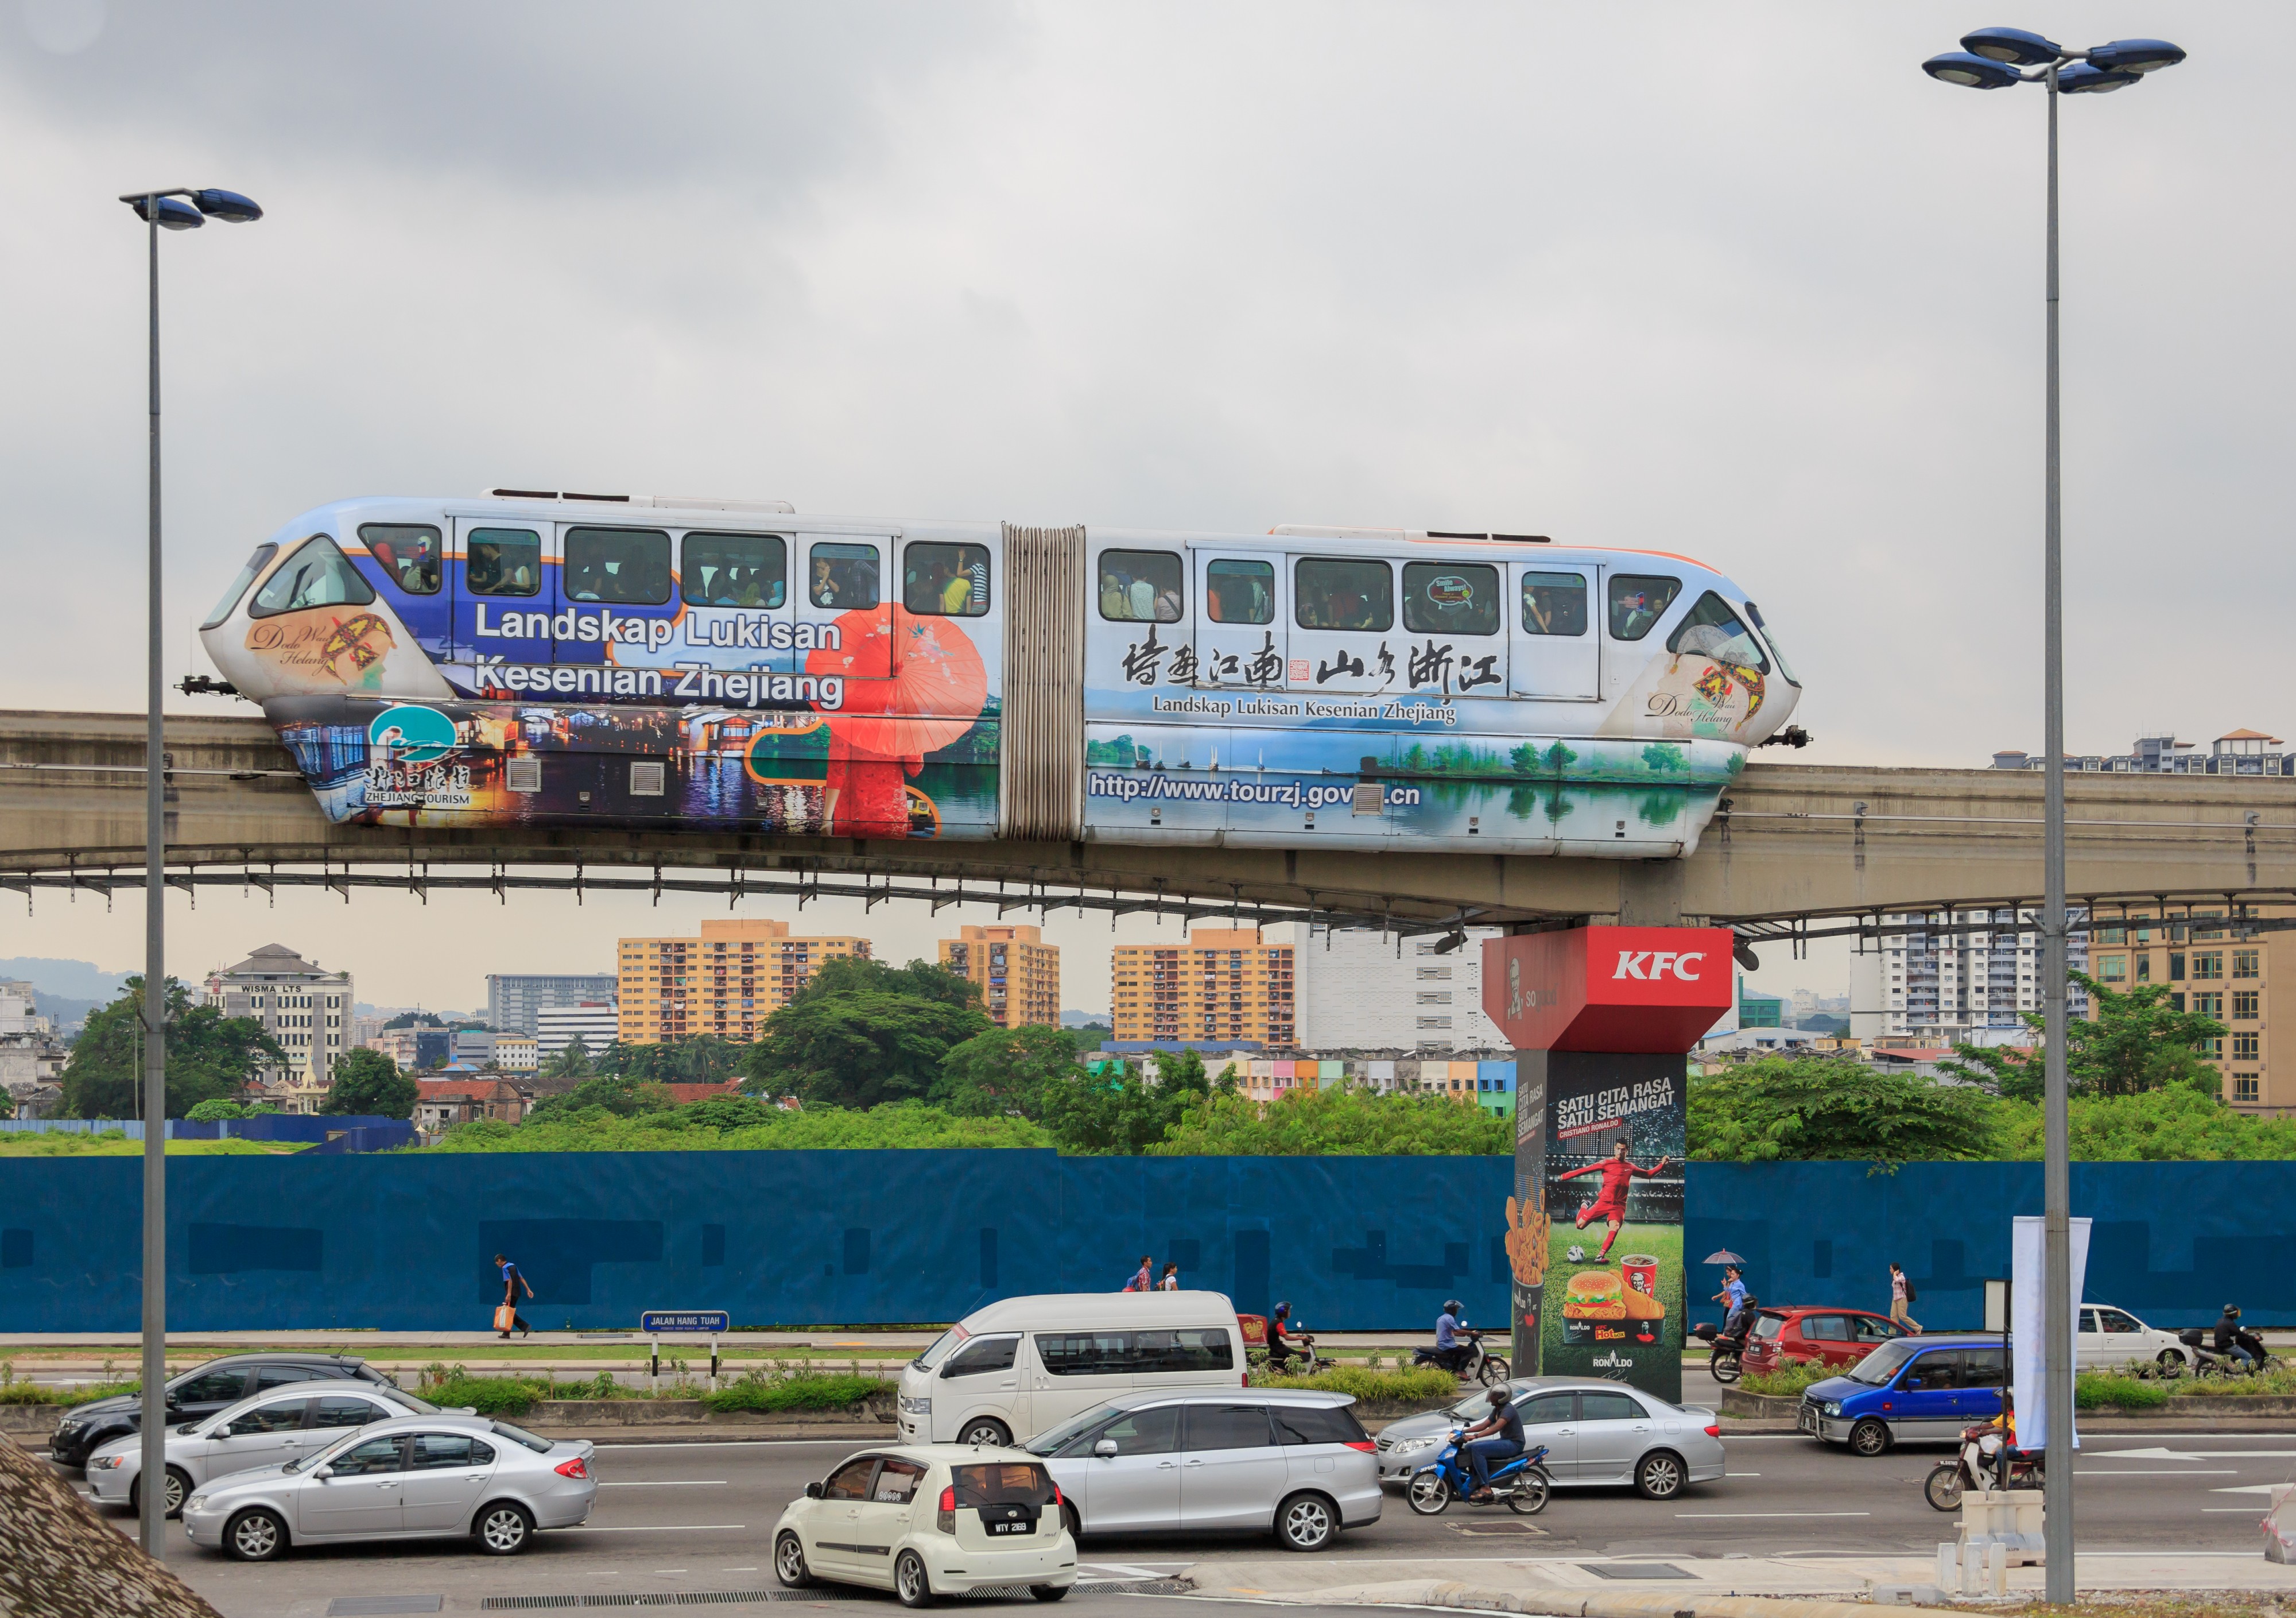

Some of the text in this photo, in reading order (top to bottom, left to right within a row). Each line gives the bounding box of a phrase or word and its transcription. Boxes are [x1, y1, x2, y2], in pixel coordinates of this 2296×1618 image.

[1444, 584, 1466, 592] Always!
[250, 624, 300, 650] Dodo
[476, 604, 840, 652] Landskap Lukisan
[280, 651, 329, 676] Helang
[476, 655, 842, 709] Kesenian Zhejiang
[1154, 696, 1456, 725] Landskap Lukisan Kesenian Zhejiang
[1644, 692, 1693, 717] Dodo
[1690, 709, 1733, 734] Helang
[1612, 951, 1704, 981] KFC
[1518, 1081, 1529, 1098] SATU
[1518, 1083, 1543, 1112] CITA RASA
[1558, 1077, 1671, 1114] SATU CITA RASA
[1518, 1107, 1528, 1124] SATU
[1558, 1091, 1675, 1129] SATU SEMANGAT
[1518, 1108, 1544, 1138] SEMANGAT
[1560, 1119, 1619, 1139] CRISTIANO RONALDO
[651, 1317, 674, 1325] JALAN
[701, 1317, 720, 1325] TUAH
[1596, 1329, 1614, 1339] Hot
[1593, 1355, 1632, 1367] RONALDO
[995, 1523, 1026, 1532] WTY 2169
